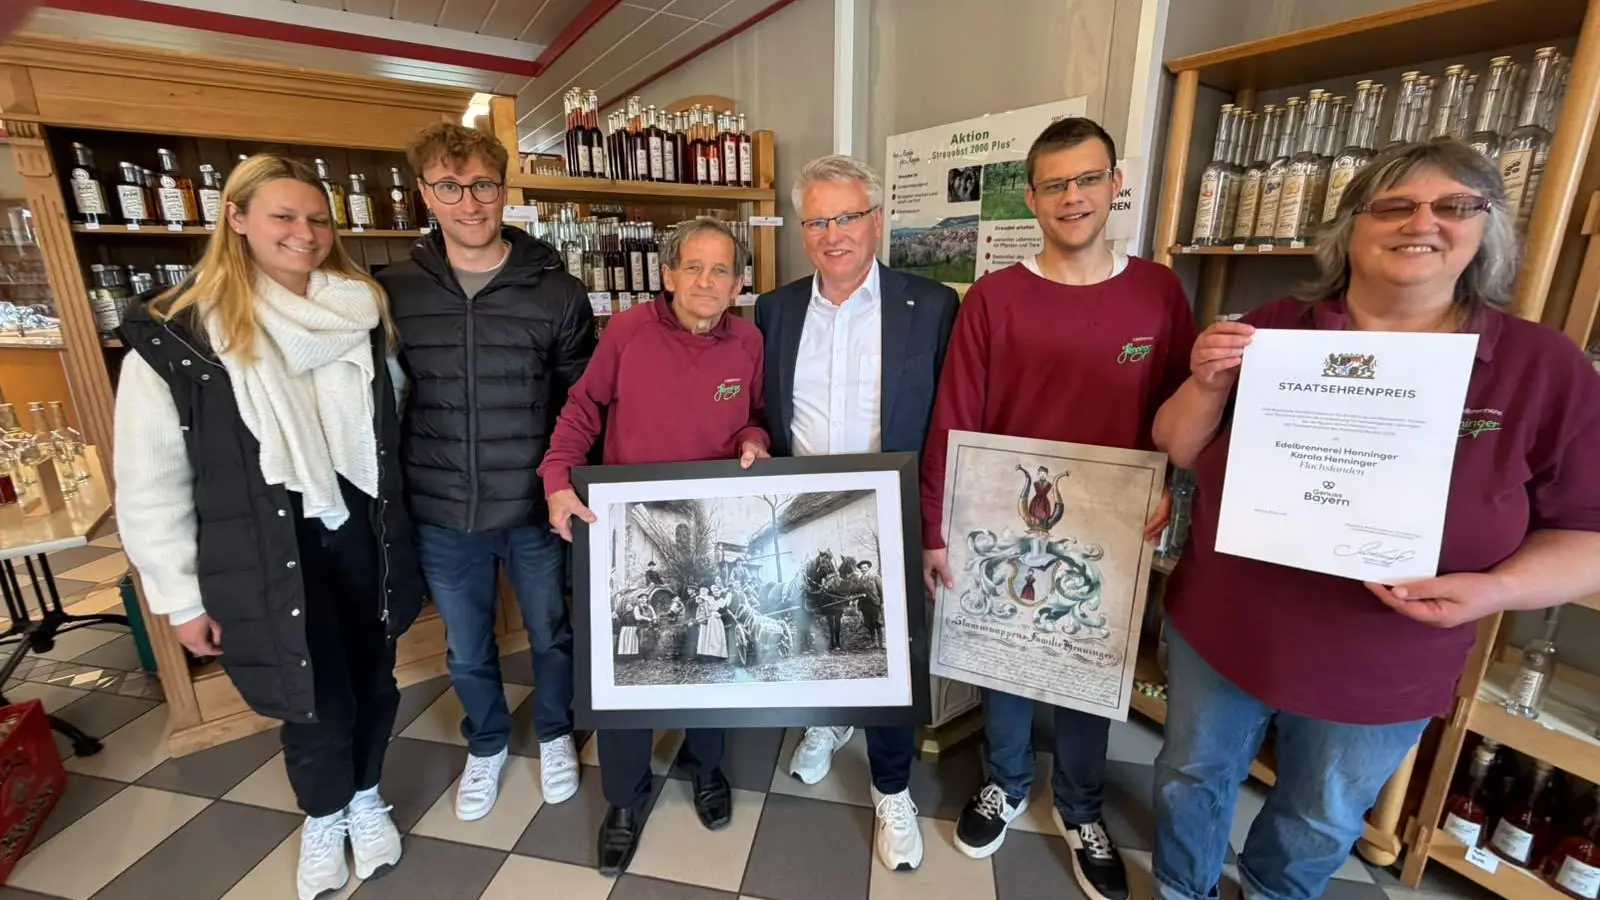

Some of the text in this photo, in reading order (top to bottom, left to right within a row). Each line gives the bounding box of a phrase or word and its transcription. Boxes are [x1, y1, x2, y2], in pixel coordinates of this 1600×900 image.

[950, 131, 990, 145] Aktion
[970, 143, 989, 154] 2000
[1116, 188, 1132, 198] NK
[1109, 201, 1131, 211] REN
[1278, 382, 1417, 399] STAATSEHRENPREIS
[1275, 440, 1399, 461] Edelbrennerei Henninger
[1290, 451, 1378, 468] Karola Henninger
[1299, 460, 1365, 476] Flachslanden
[1304, 491, 1350, 507] Bayern
[1312, 488, 1343, 498] Genuss
